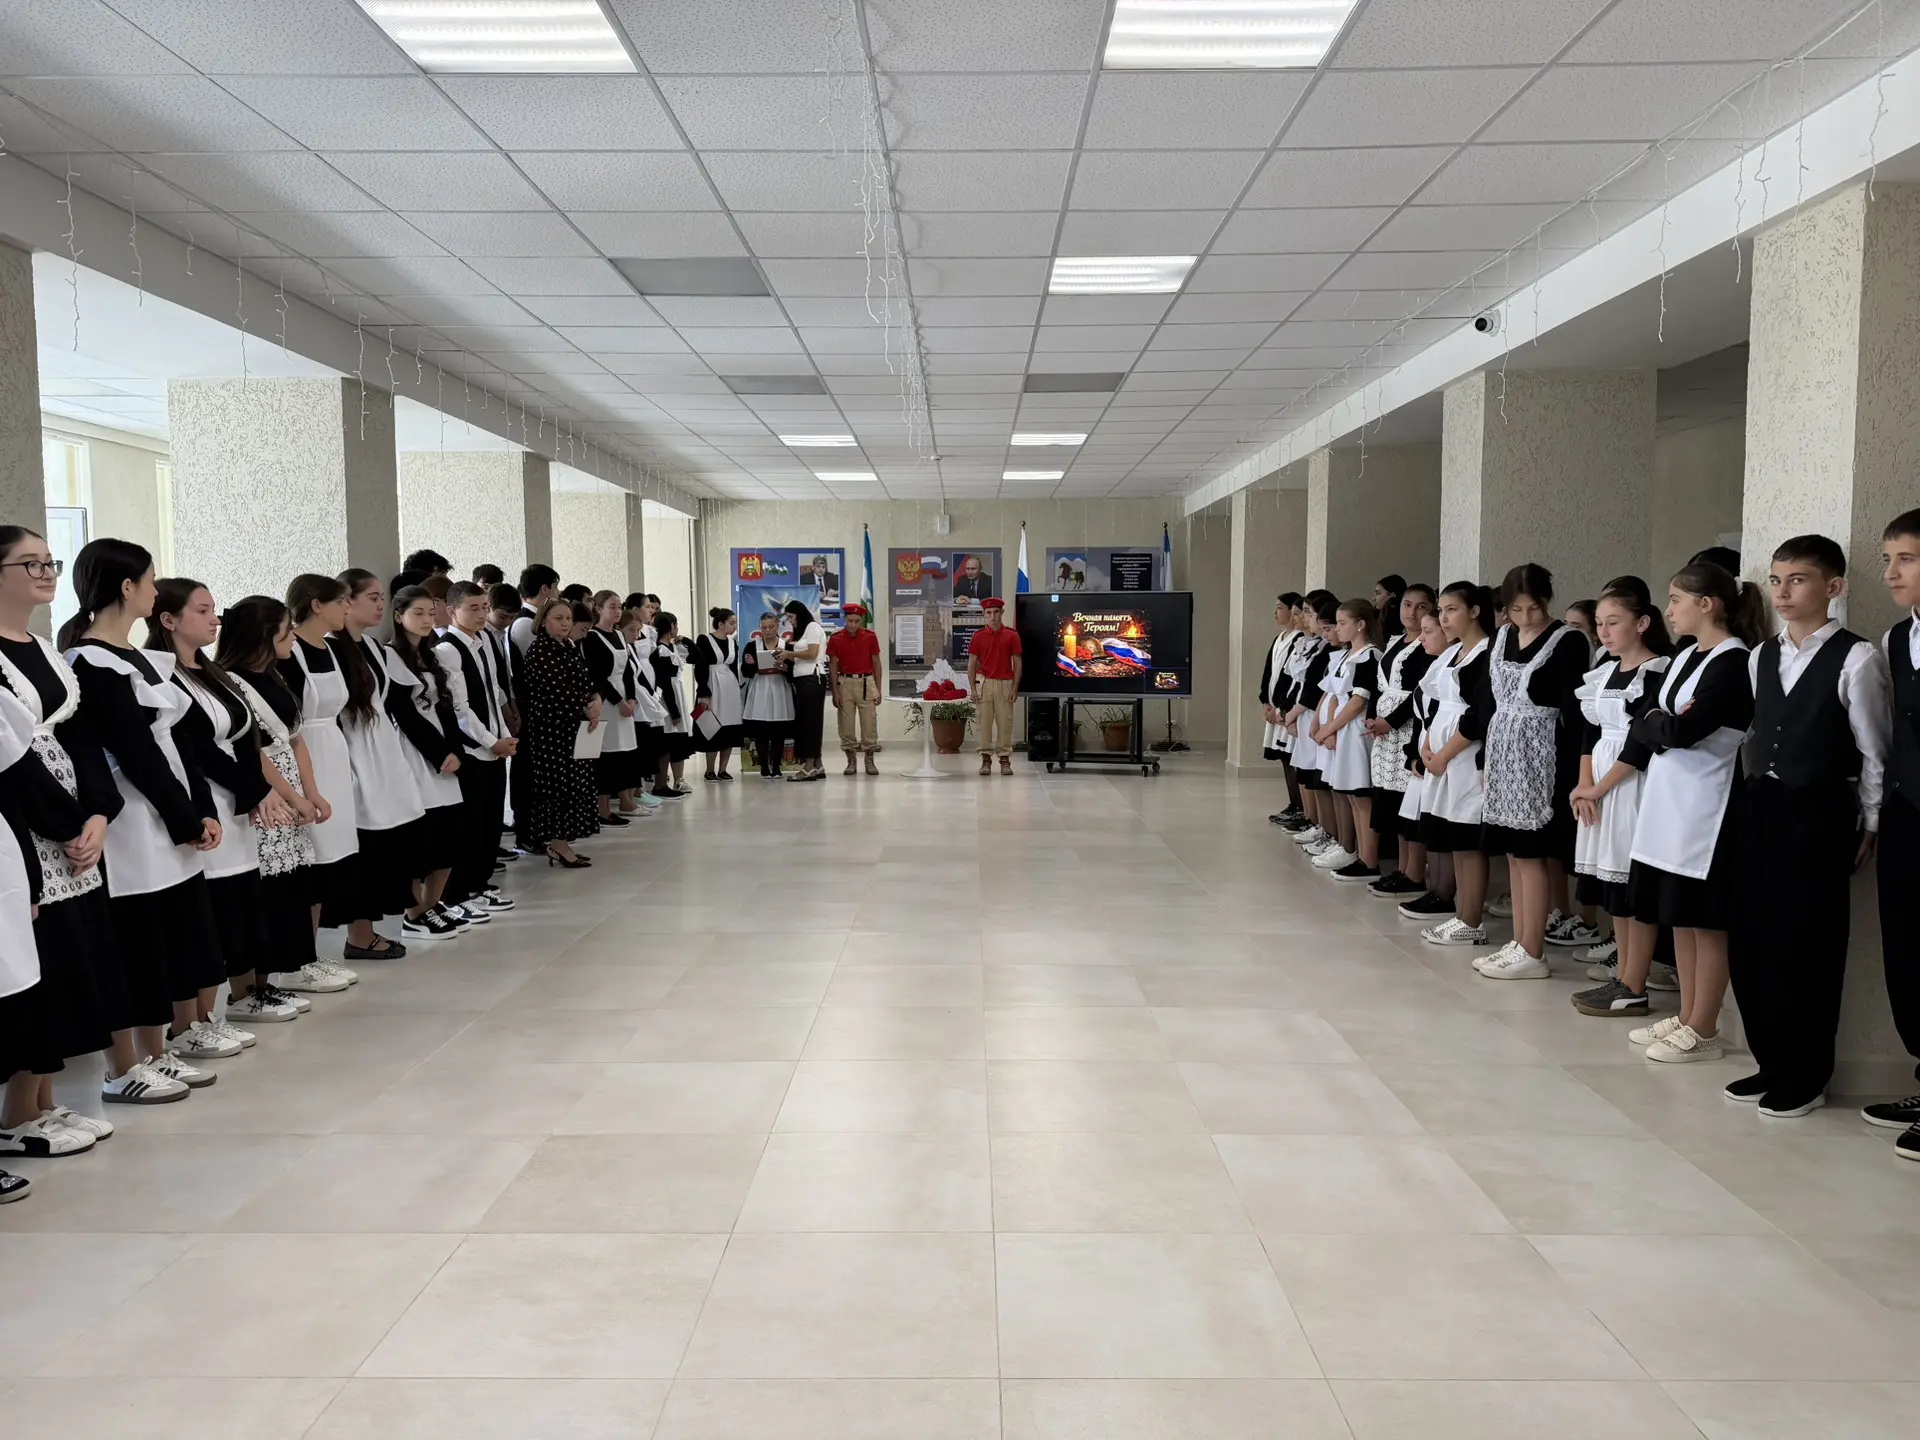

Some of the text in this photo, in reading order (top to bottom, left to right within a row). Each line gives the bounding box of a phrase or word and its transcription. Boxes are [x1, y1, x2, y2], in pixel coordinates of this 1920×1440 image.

[1072, 612, 1132, 622] Вечная память
[1083, 622, 1120, 634] Героям!
